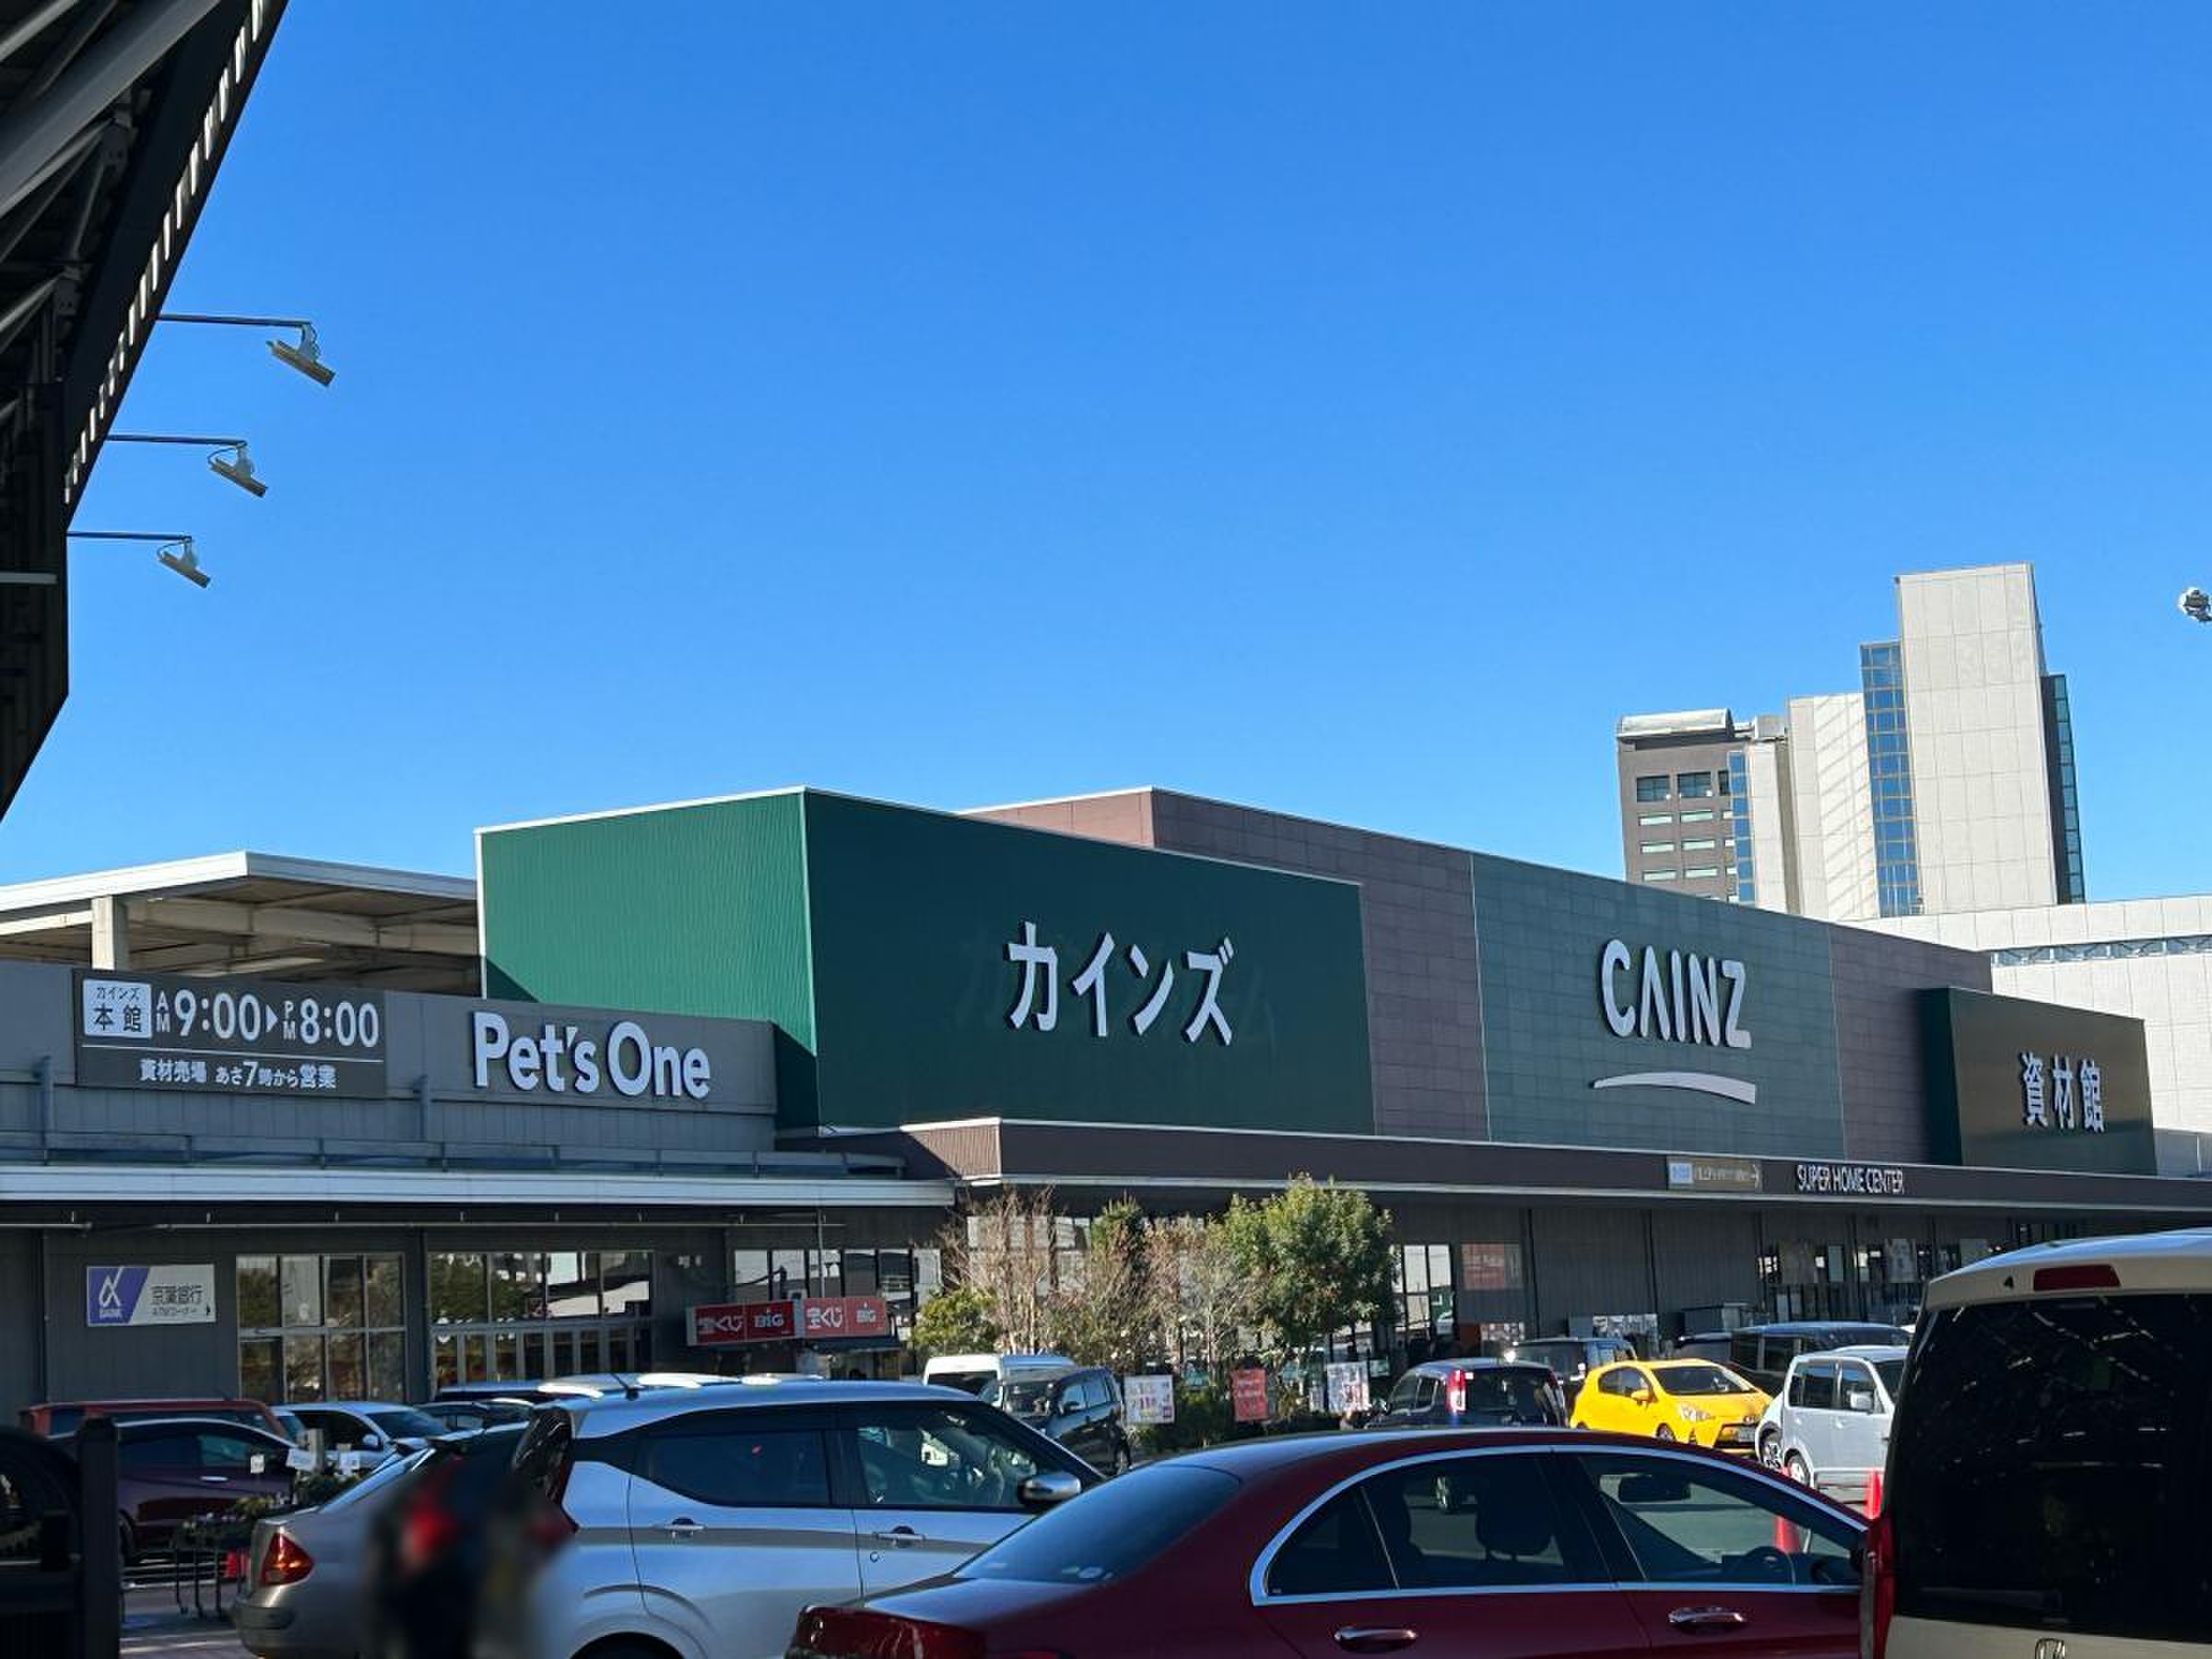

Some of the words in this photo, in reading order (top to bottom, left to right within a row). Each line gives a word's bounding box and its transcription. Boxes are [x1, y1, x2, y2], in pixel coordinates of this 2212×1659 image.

[94, 1003, 143, 1032] 本館
[174, 989, 261, 1041] 9:00
[300, 998, 379, 1048] 8:00
[1007, 921, 1234, 1046] カインズ
[1601, 938, 1752, 1049] CAINZ
[2021, 1051, 2105, 1133] 資材館
[1797, 1164, 1831, 1192] SUPER
[1831, 1165, 1866, 1193] HOME
[1865, 1168, 1905, 1195] CENTER
